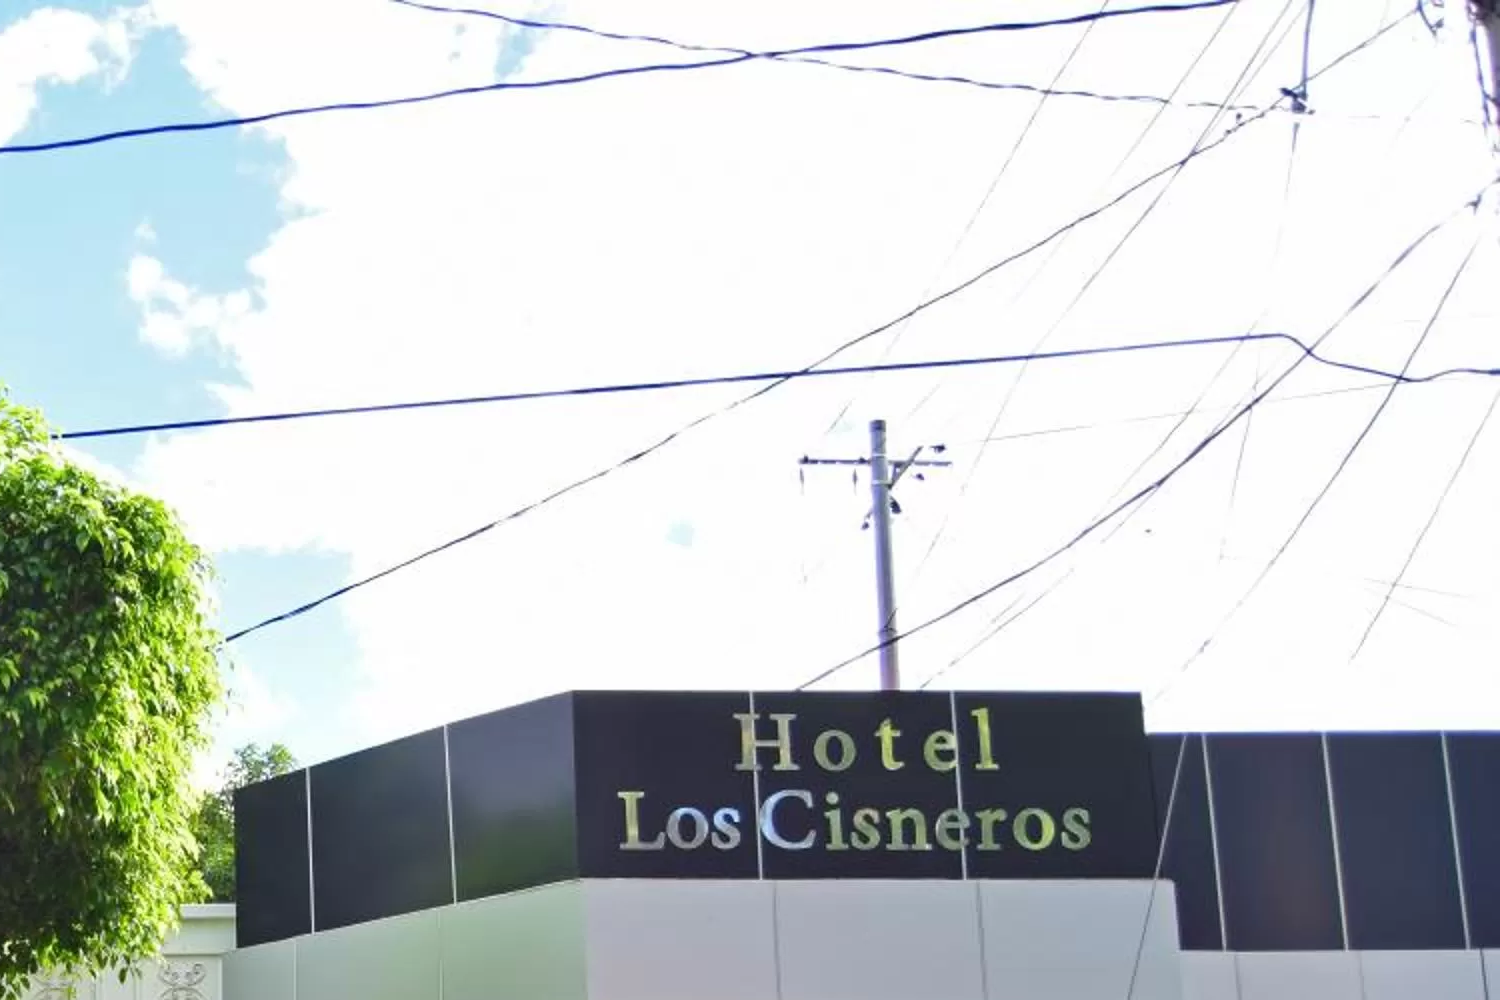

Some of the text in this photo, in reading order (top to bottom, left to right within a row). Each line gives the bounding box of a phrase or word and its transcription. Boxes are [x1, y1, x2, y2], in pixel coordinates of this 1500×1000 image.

[733, 707, 998, 771] Hotel
[617, 789, 1092, 851] Los Cisneros
